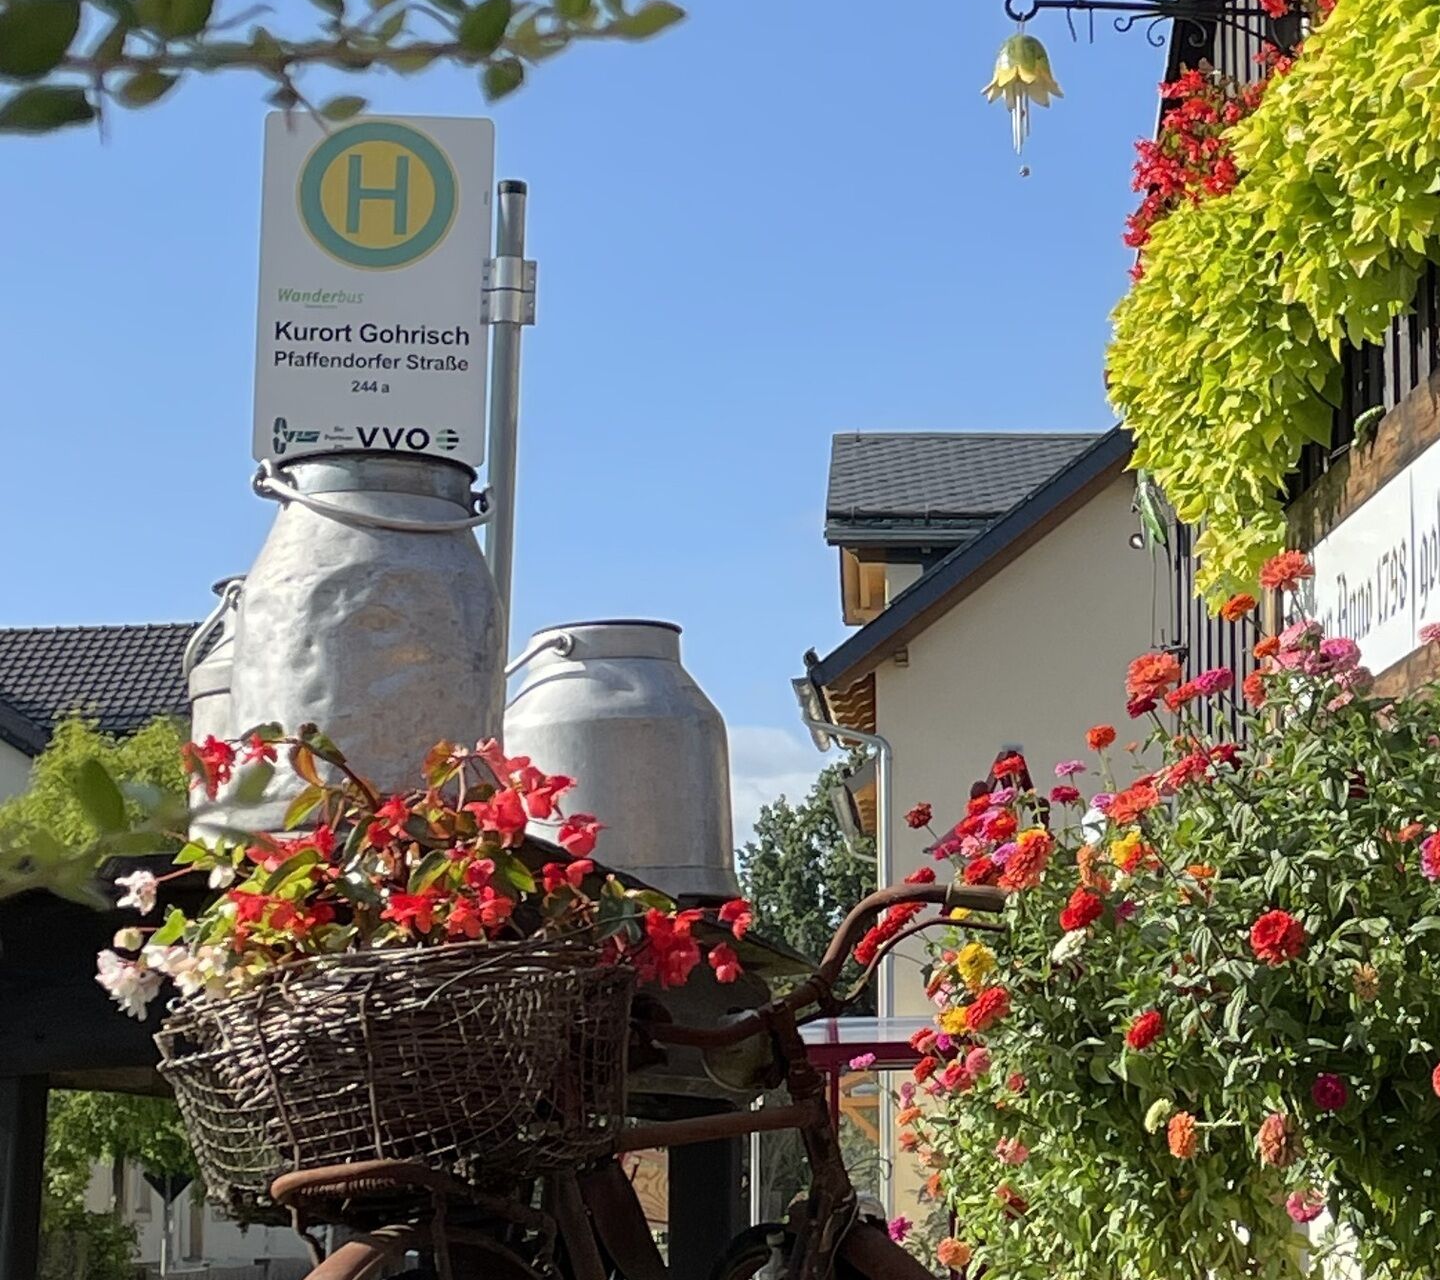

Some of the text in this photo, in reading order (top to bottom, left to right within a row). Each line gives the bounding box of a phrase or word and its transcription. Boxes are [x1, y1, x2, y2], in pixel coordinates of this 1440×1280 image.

[277, 287, 365, 304] Wanderbus
[274, 320, 470, 346] Kurort Gohrisch
[273, 351, 469, 372] Pfaffendorfer Straße
[351, 380, 390, 394] 244 a
[356, 426, 430, 451] VVO
[1377, 537, 1408, 626] 1798
